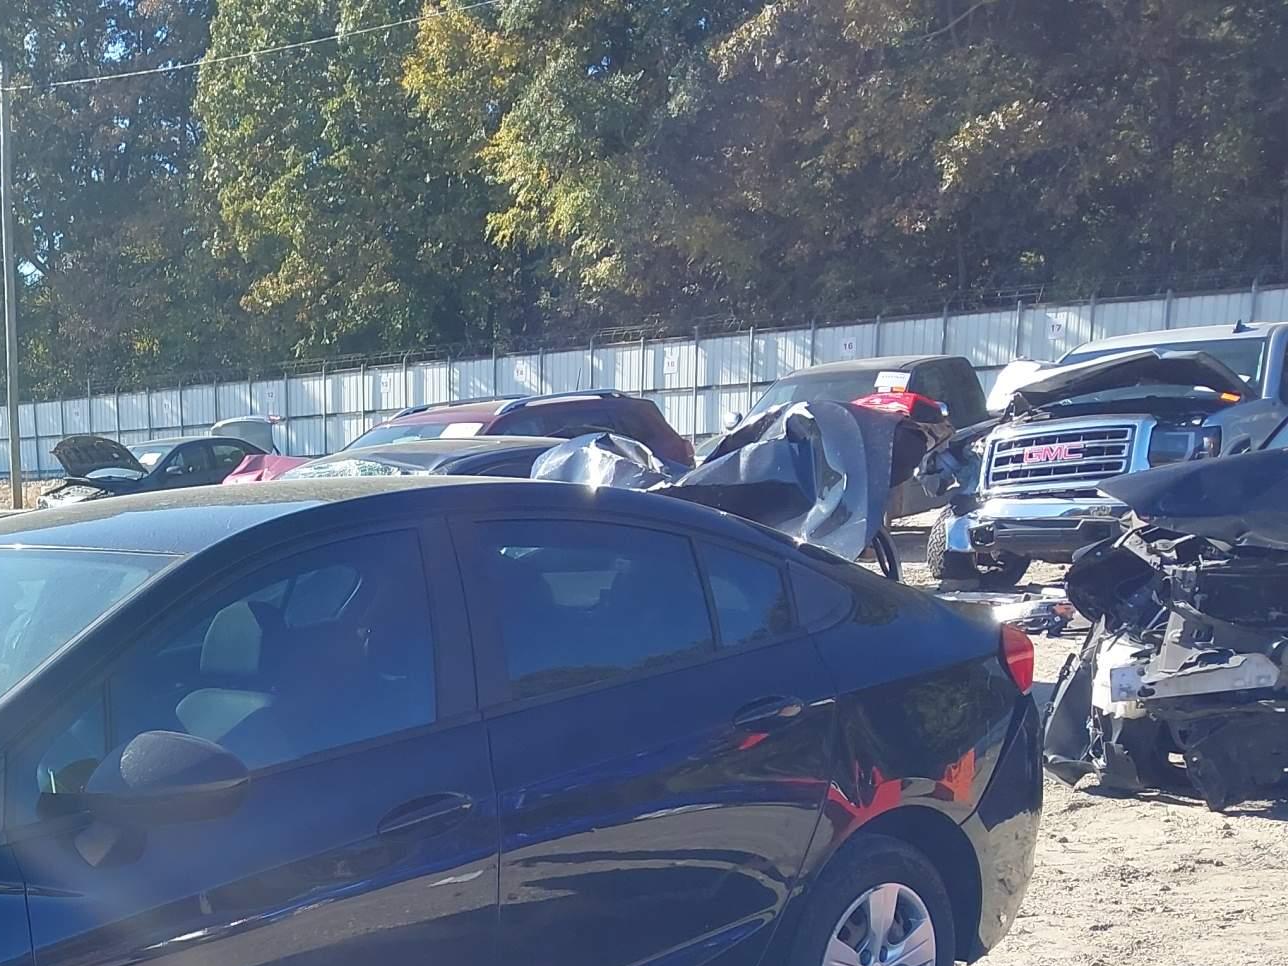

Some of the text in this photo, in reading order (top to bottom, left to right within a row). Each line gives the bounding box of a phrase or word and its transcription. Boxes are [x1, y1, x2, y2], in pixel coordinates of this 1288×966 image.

[1051, 323, 1062, 333] 17
[843, 342, 853, 351] 16
[1023, 442, 1084, 463] GMC
